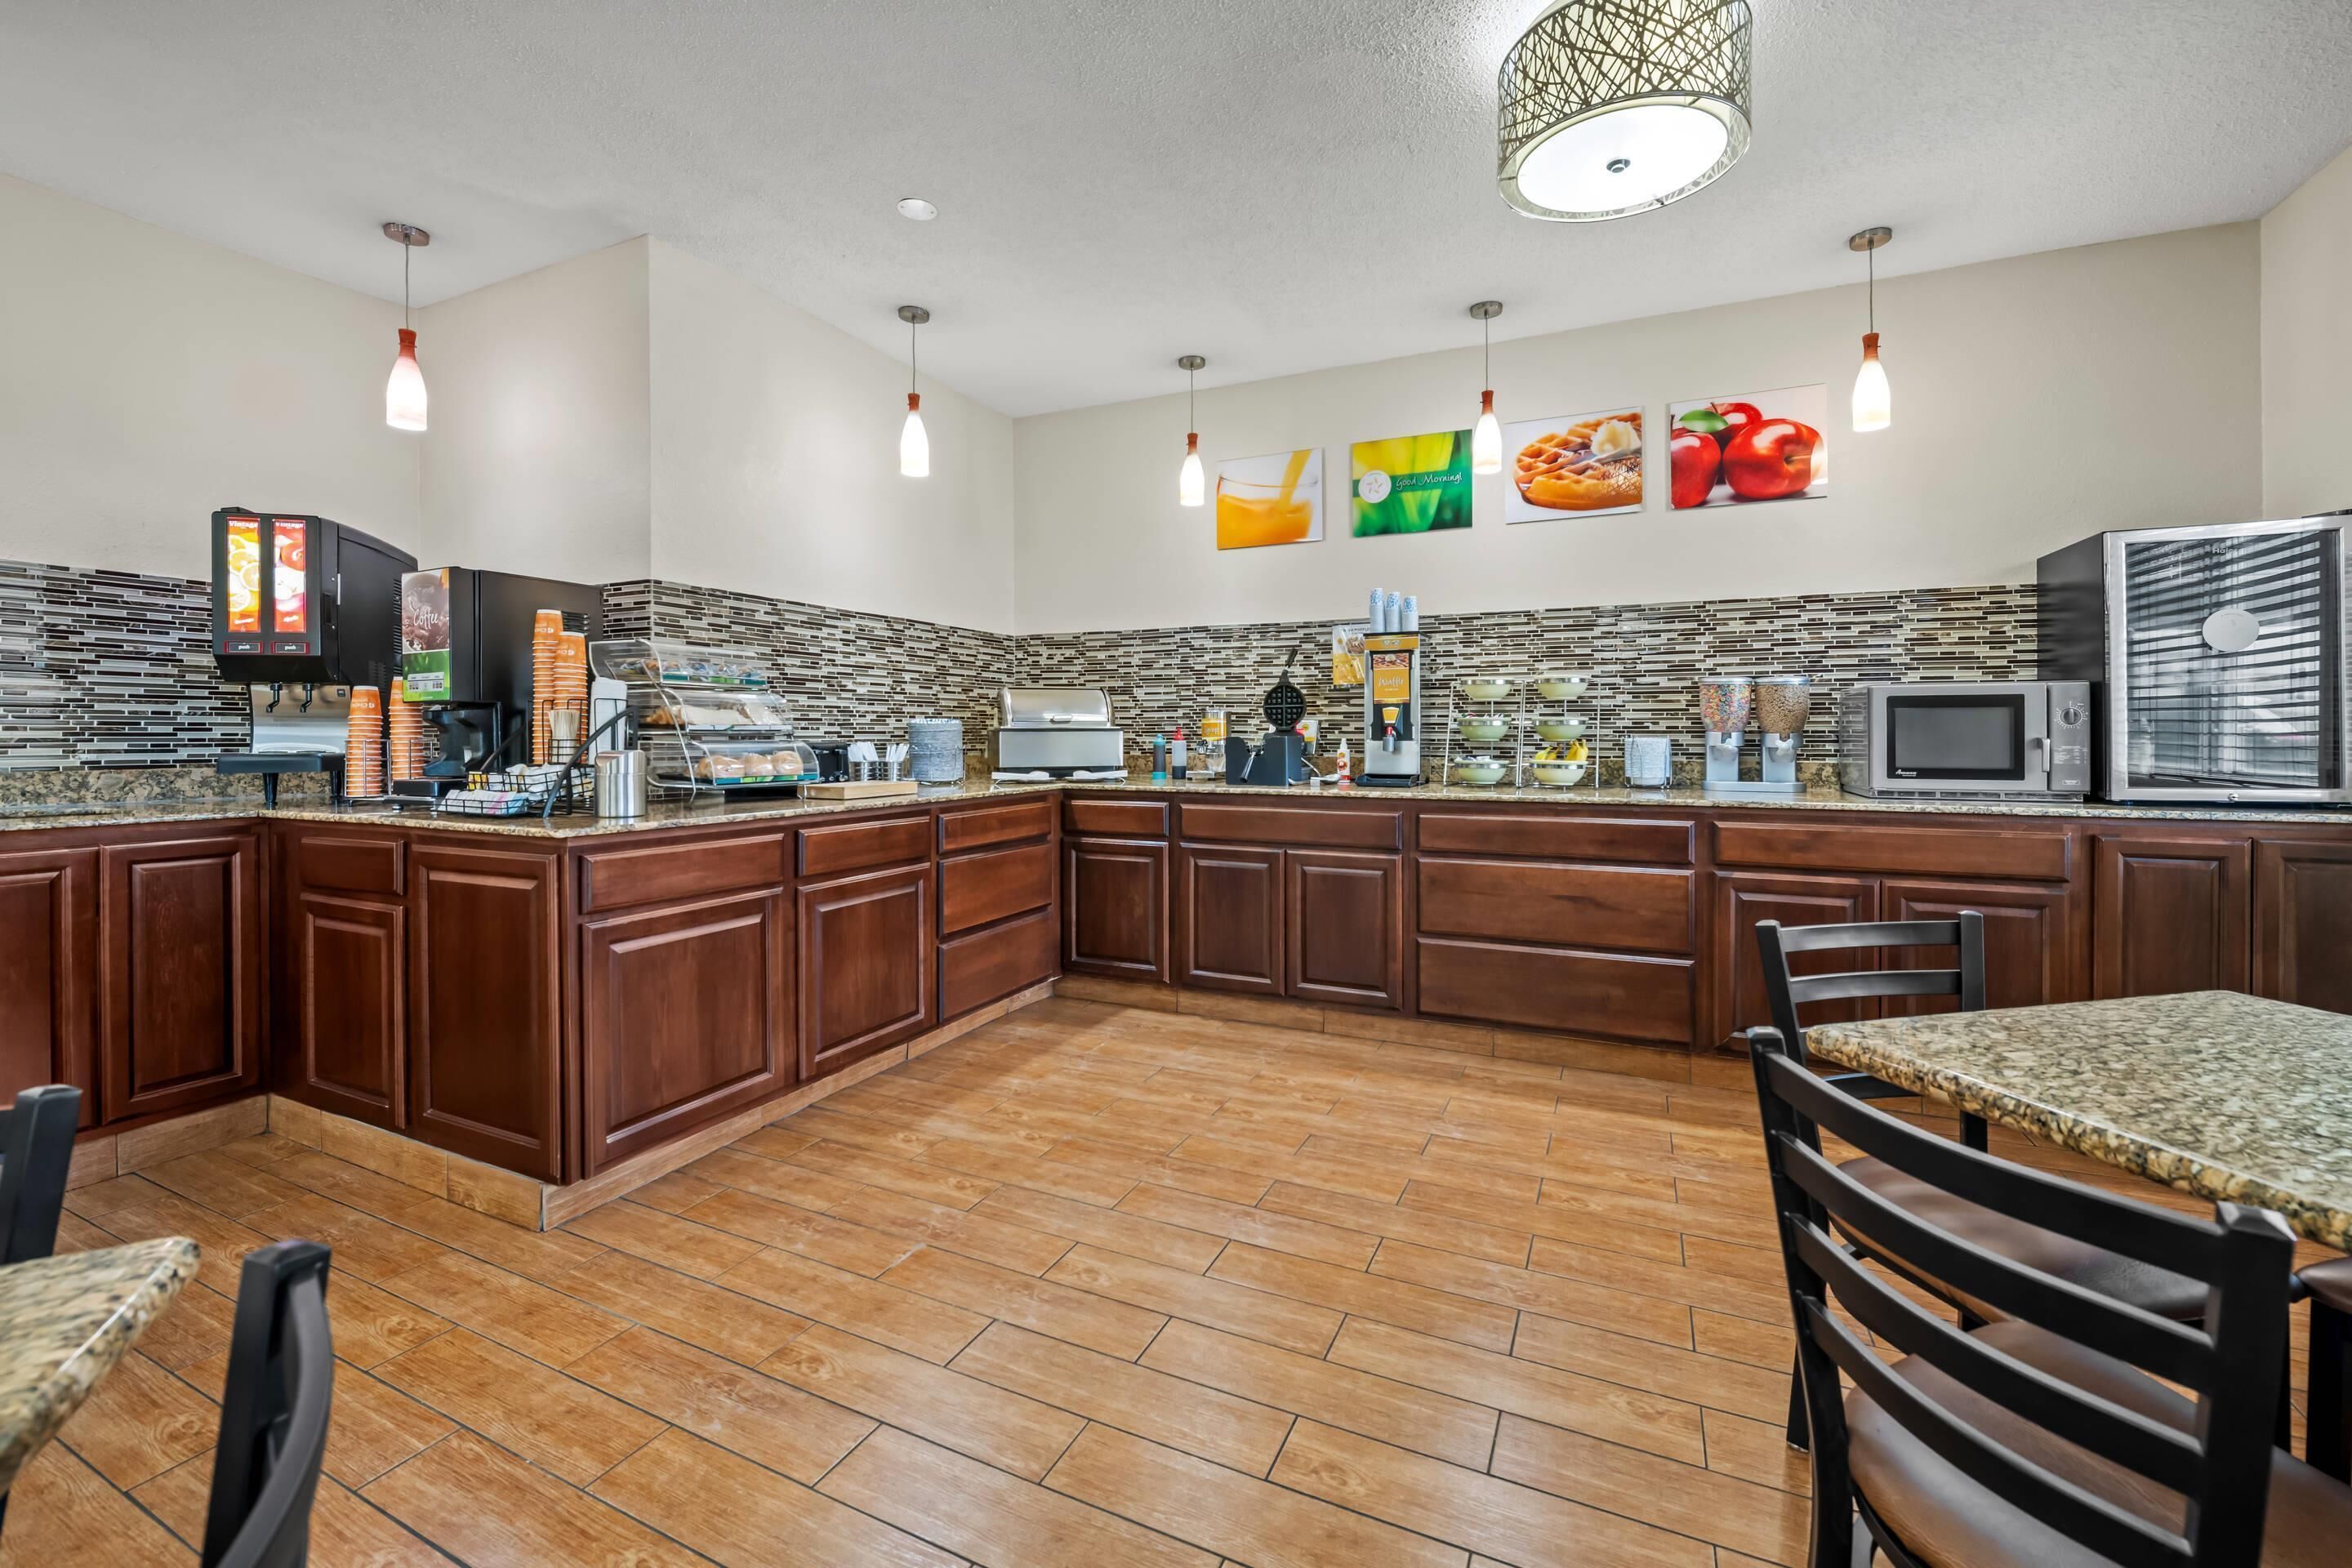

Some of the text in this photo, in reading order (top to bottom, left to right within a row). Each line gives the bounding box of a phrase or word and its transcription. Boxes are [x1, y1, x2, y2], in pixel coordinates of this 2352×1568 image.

[1396, 472, 1462, 491] Good Morning!
[229, 521, 259, 529] Vintage
[413, 608, 439, 630] Coffee
[1378, 676, 1405, 688] Waffle
